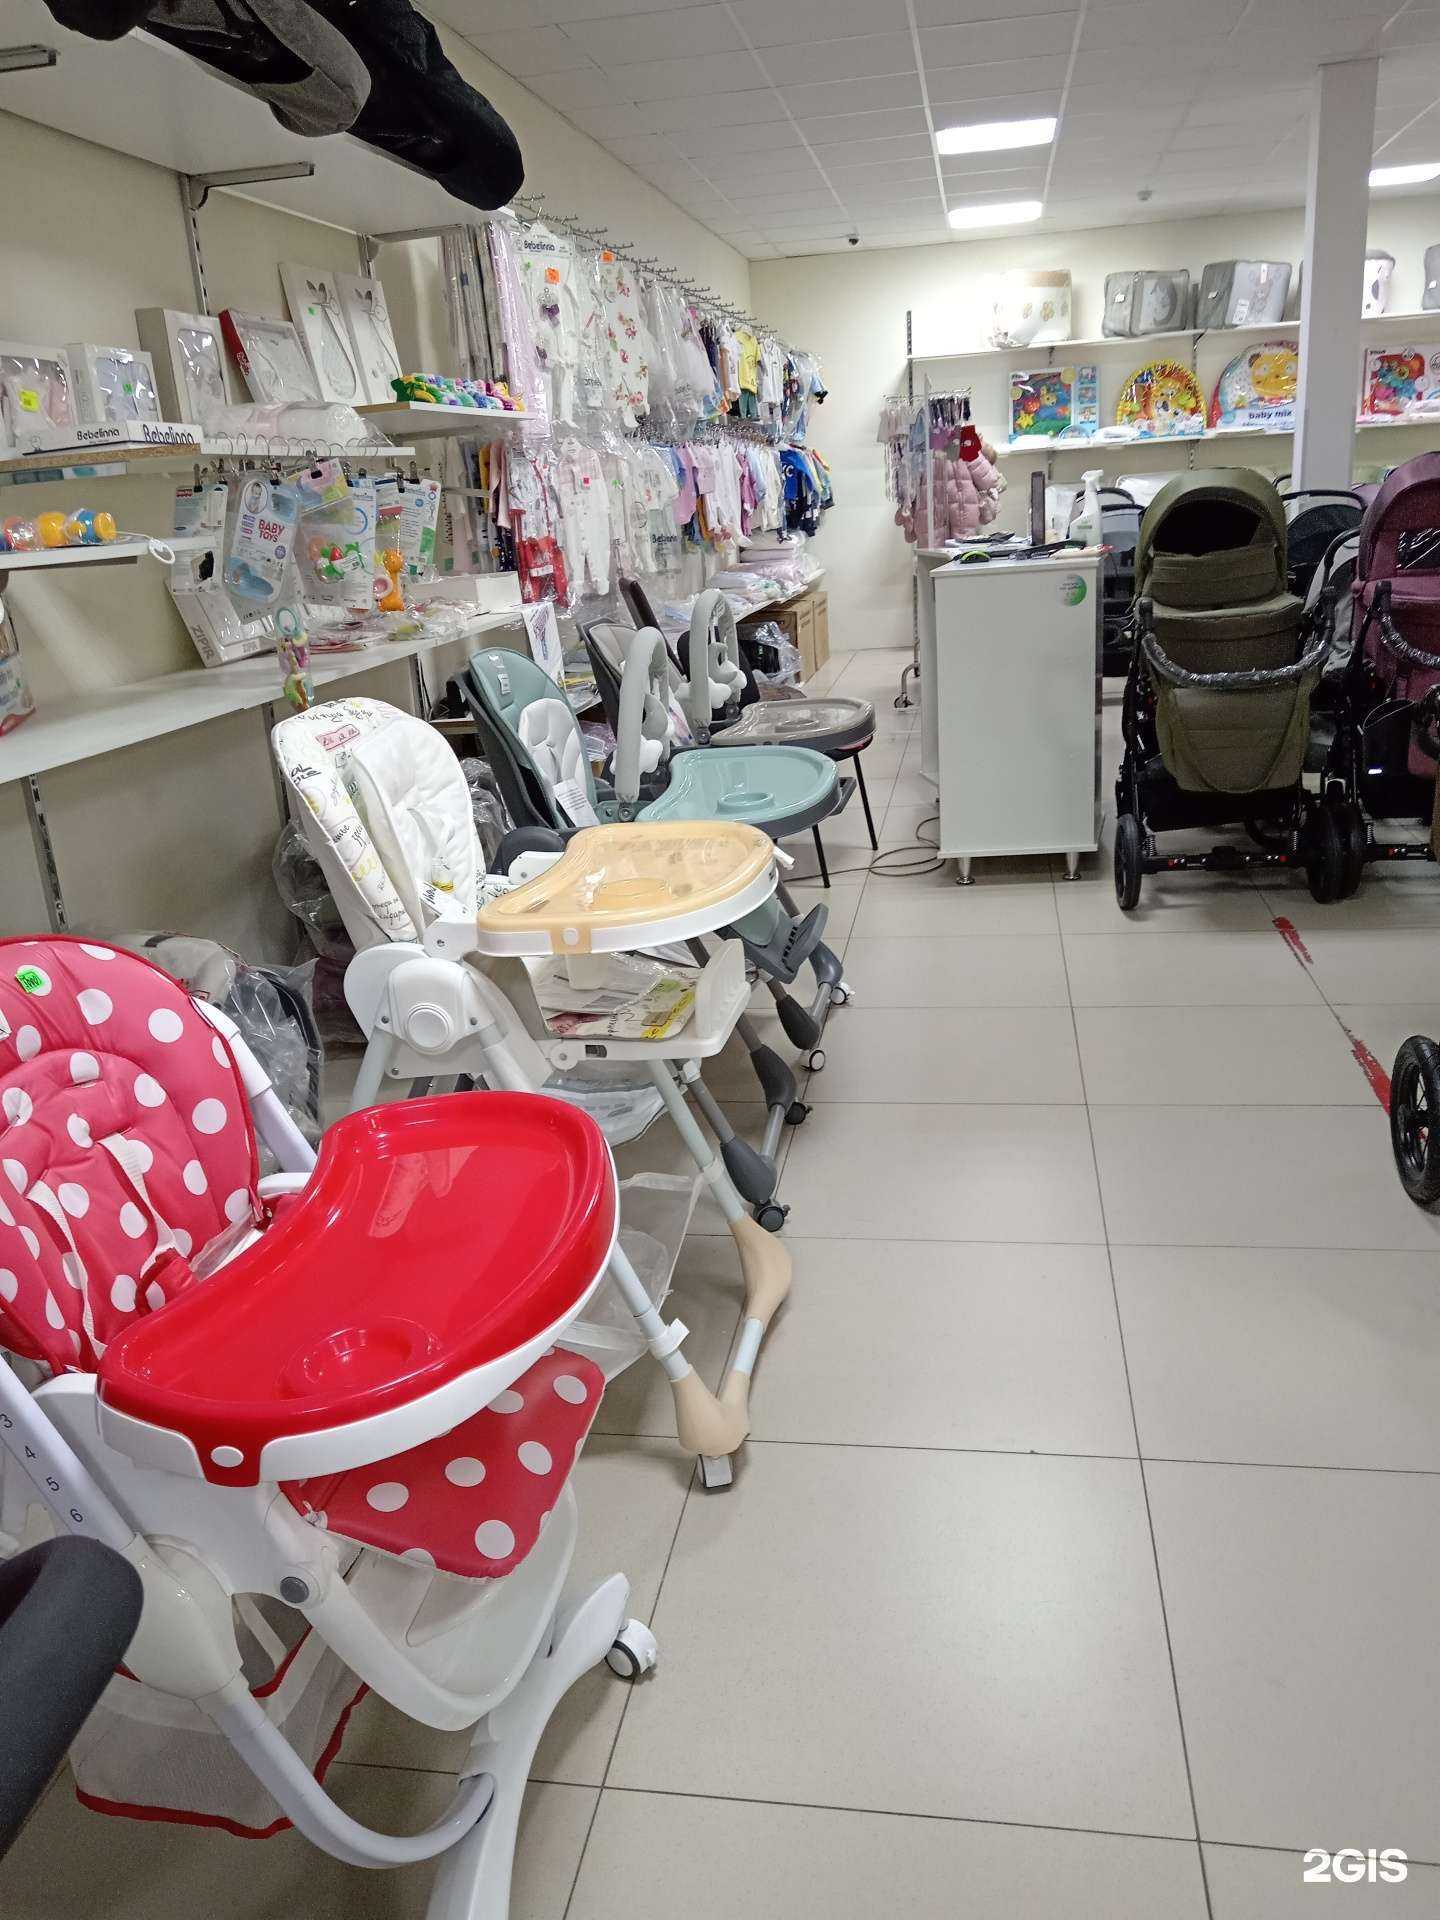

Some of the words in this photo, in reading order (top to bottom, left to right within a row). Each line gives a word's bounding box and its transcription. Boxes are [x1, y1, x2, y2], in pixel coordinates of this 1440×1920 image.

[1249, 411, 1273, 420] baby
[77, 428, 120, 441] Bebelinna
[259, 519, 284, 535] BABY
[259, 529, 279, 543] TOYS
[0, 1413, 13, 1429] 3
[24, 1445, 37, 1460] 4
[45, 1476, 61, 1492] 5
[69, 1508, 84, 1523] 6
